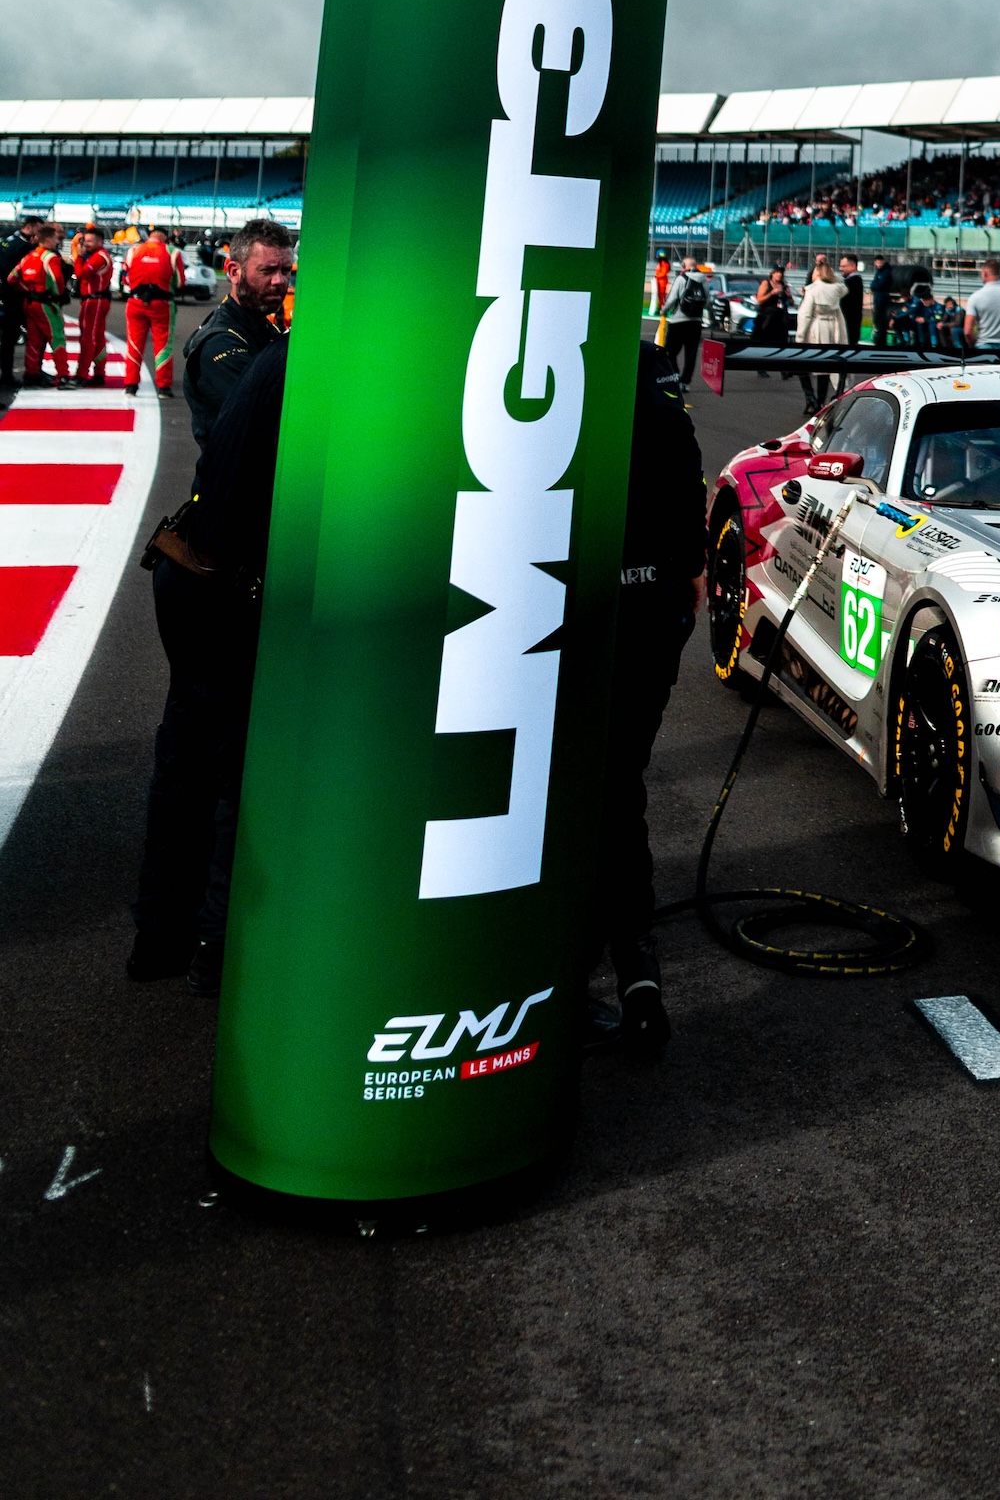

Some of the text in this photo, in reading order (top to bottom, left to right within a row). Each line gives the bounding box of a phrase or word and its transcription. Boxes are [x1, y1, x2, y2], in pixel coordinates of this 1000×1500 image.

[655, 224, 709, 236] HELICOPTERS
[843, 589, 876, 671] 62
[367, 986, 554, 1062] ELMS
[364, 1048, 531, 1086] EUROPEAN LE MANS
[363, 1085, 425, 1101] SERIES
